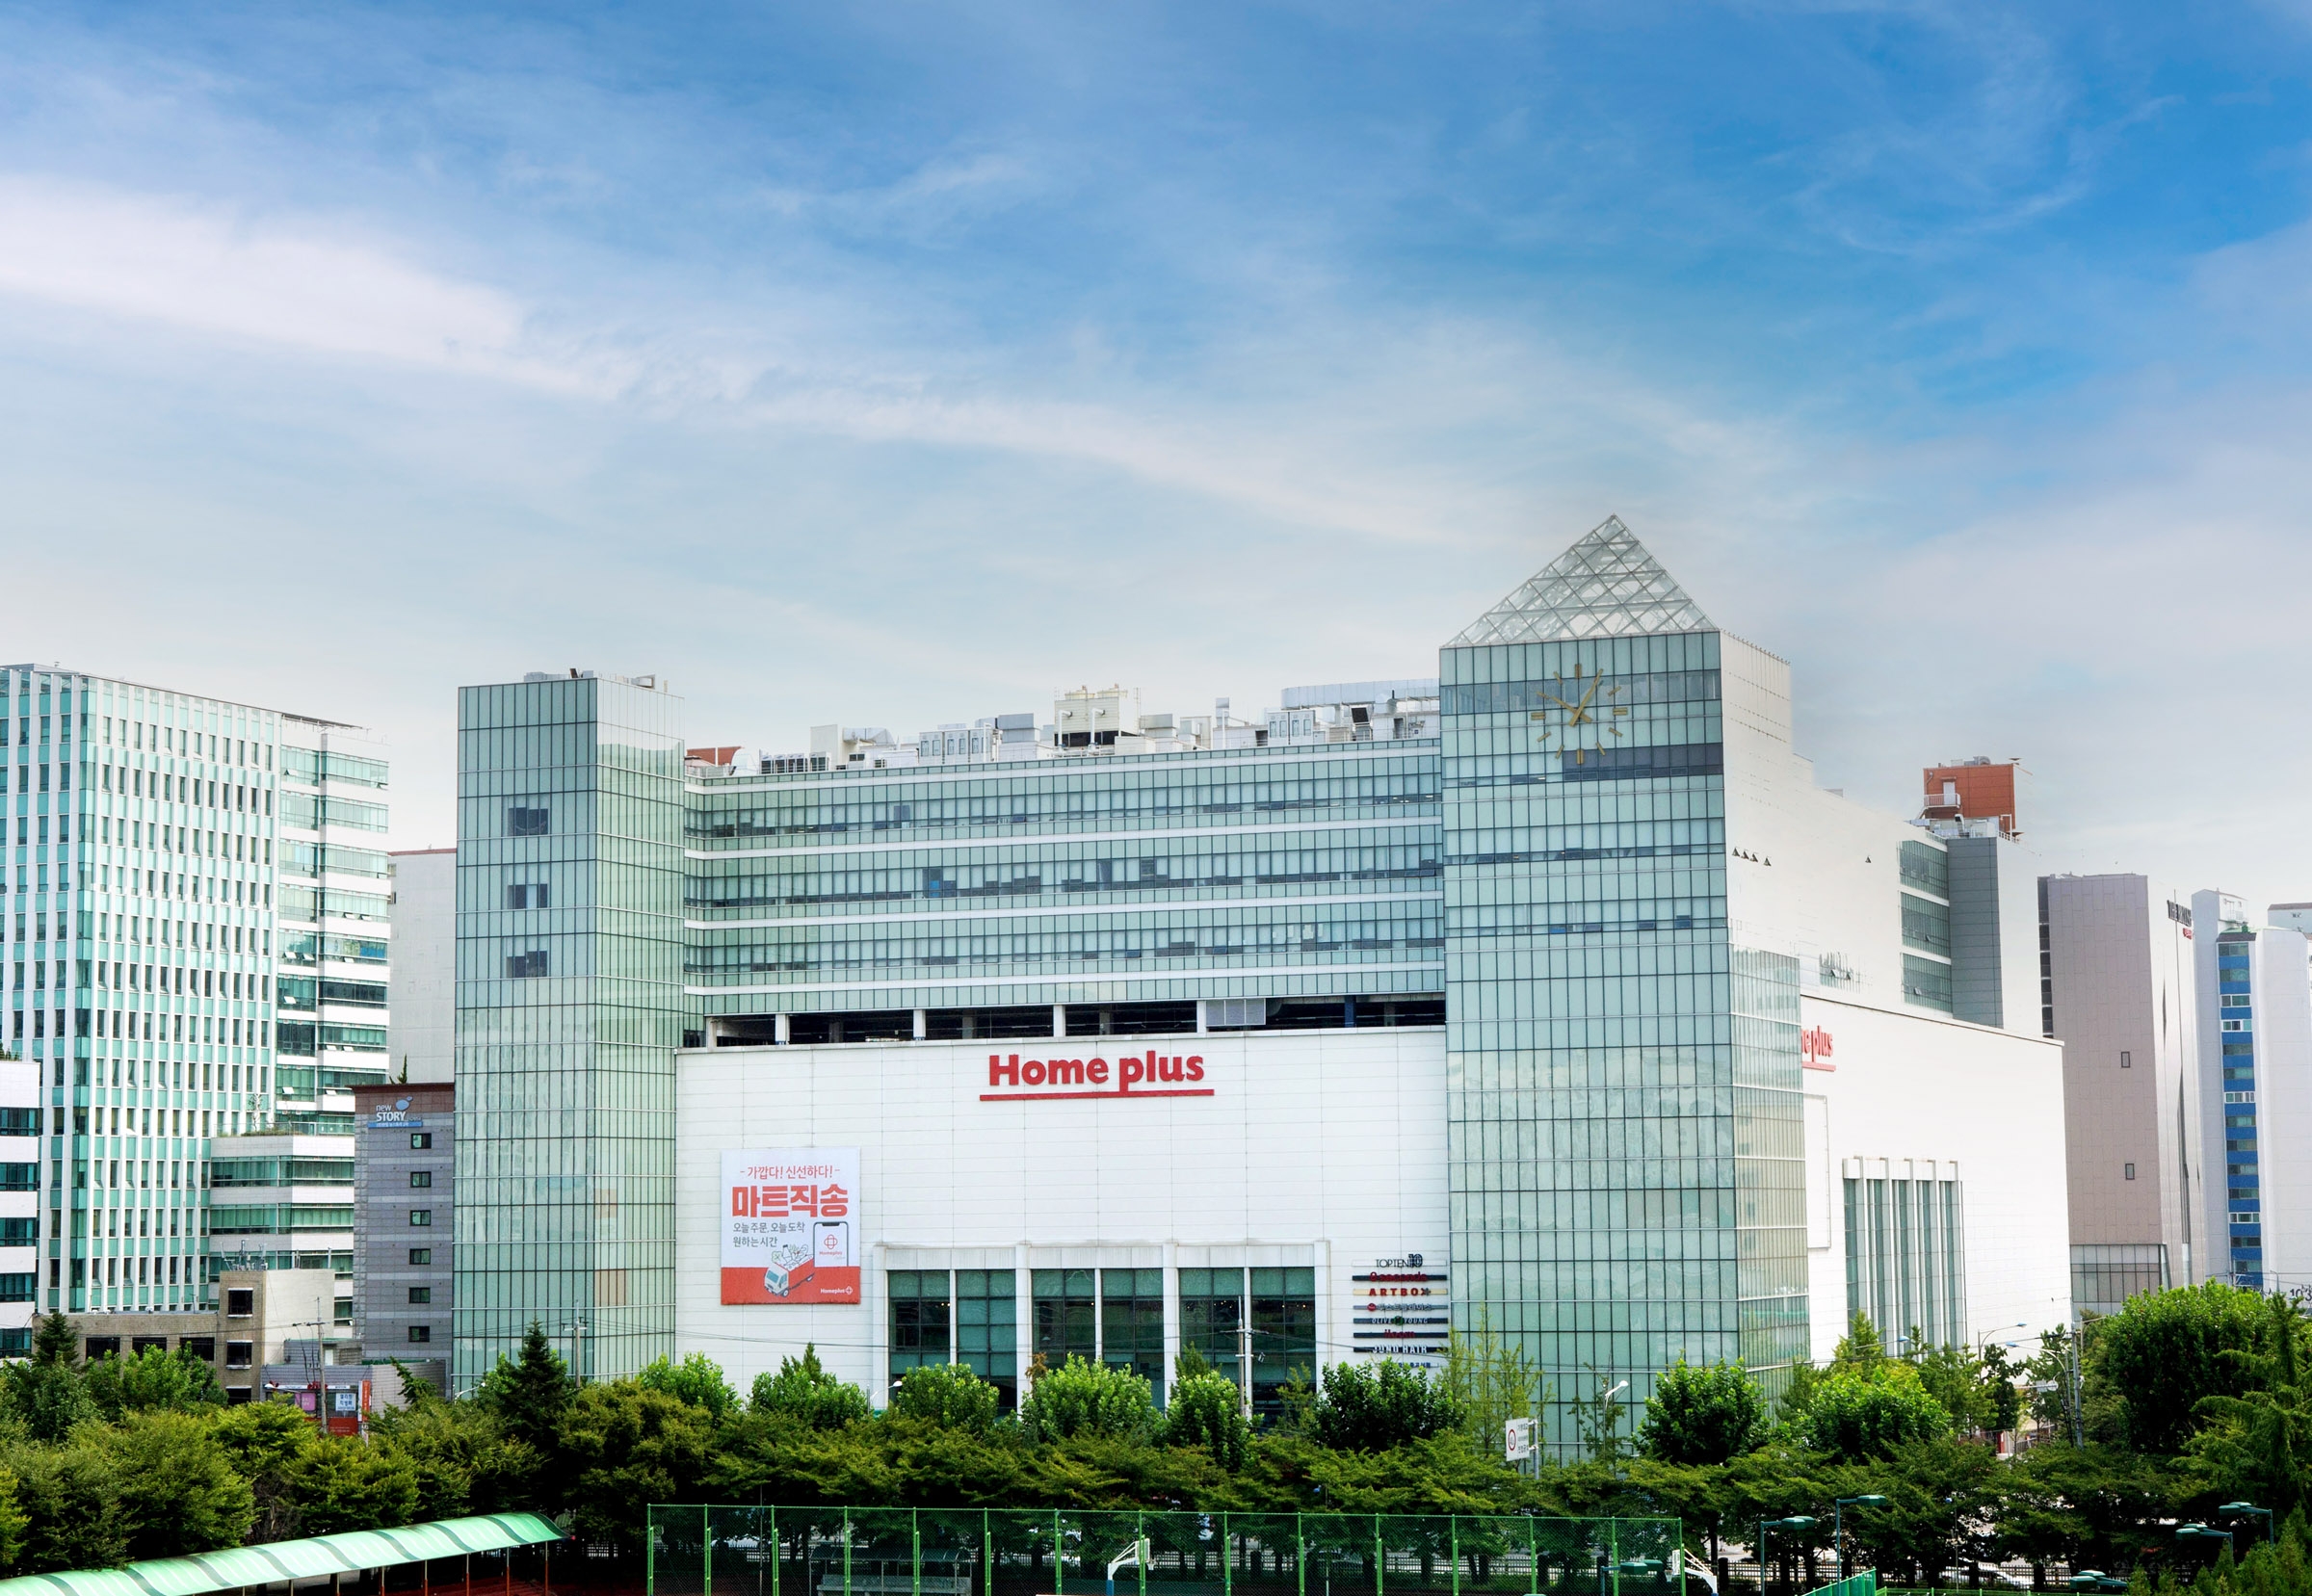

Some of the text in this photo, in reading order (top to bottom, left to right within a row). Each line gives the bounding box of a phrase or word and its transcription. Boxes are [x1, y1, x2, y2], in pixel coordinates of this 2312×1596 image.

[1811, 1025, 1833, 1062] plus
[989, 1050, 1204, 1092] Home plus
[376, 1112, 406, 1121] STORY
[748, 1164, 833, 1180] 가깝다! 신선하다!
[732, 1184, 849, 1217] 마트직송
[1369, 1288, 1430, 1296] ARTBOX
[1403, 1345, 1428, 1354] HAIR
